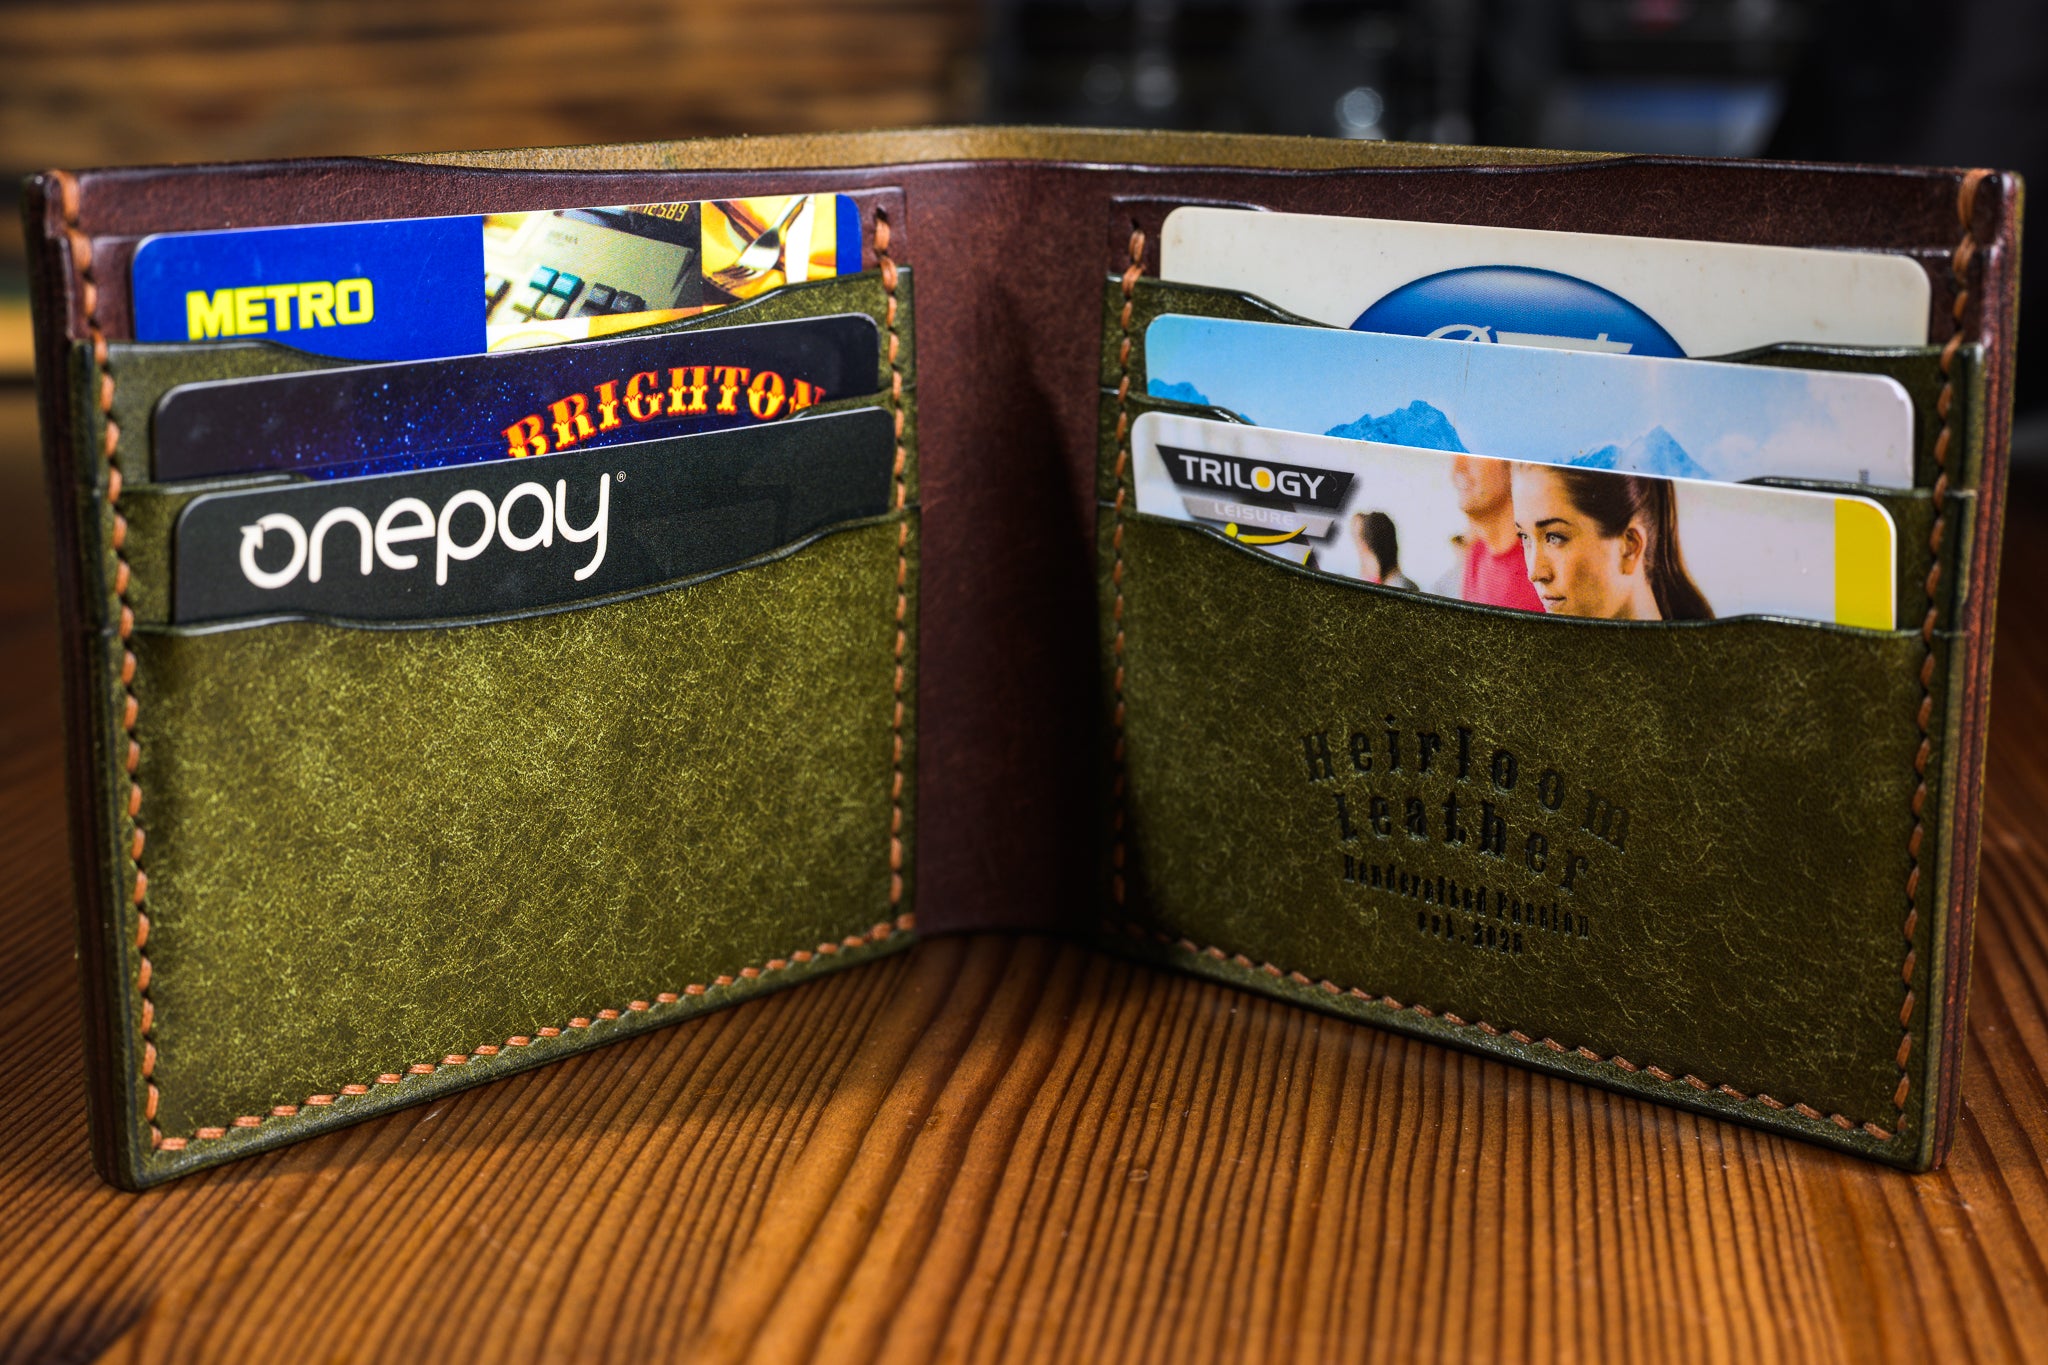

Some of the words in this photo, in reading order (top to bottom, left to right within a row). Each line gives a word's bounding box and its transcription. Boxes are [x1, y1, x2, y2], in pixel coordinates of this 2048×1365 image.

[186, 277, 374, 341] METRO
[502, 366, 827, 459] BRIGHTON
[1178, 454, 1325, 500] TRILOGY
[1213, 502, 1296, 527] LEISURE
[240, 473, 611, 589] onepay
[1301, 713, 1631, 854] Heirloom
[1332, 791, 1590, 896] Leather
[1343, 854, 1487, 917] Handcrafted
[1496, 892, 1590, 940] Passion
